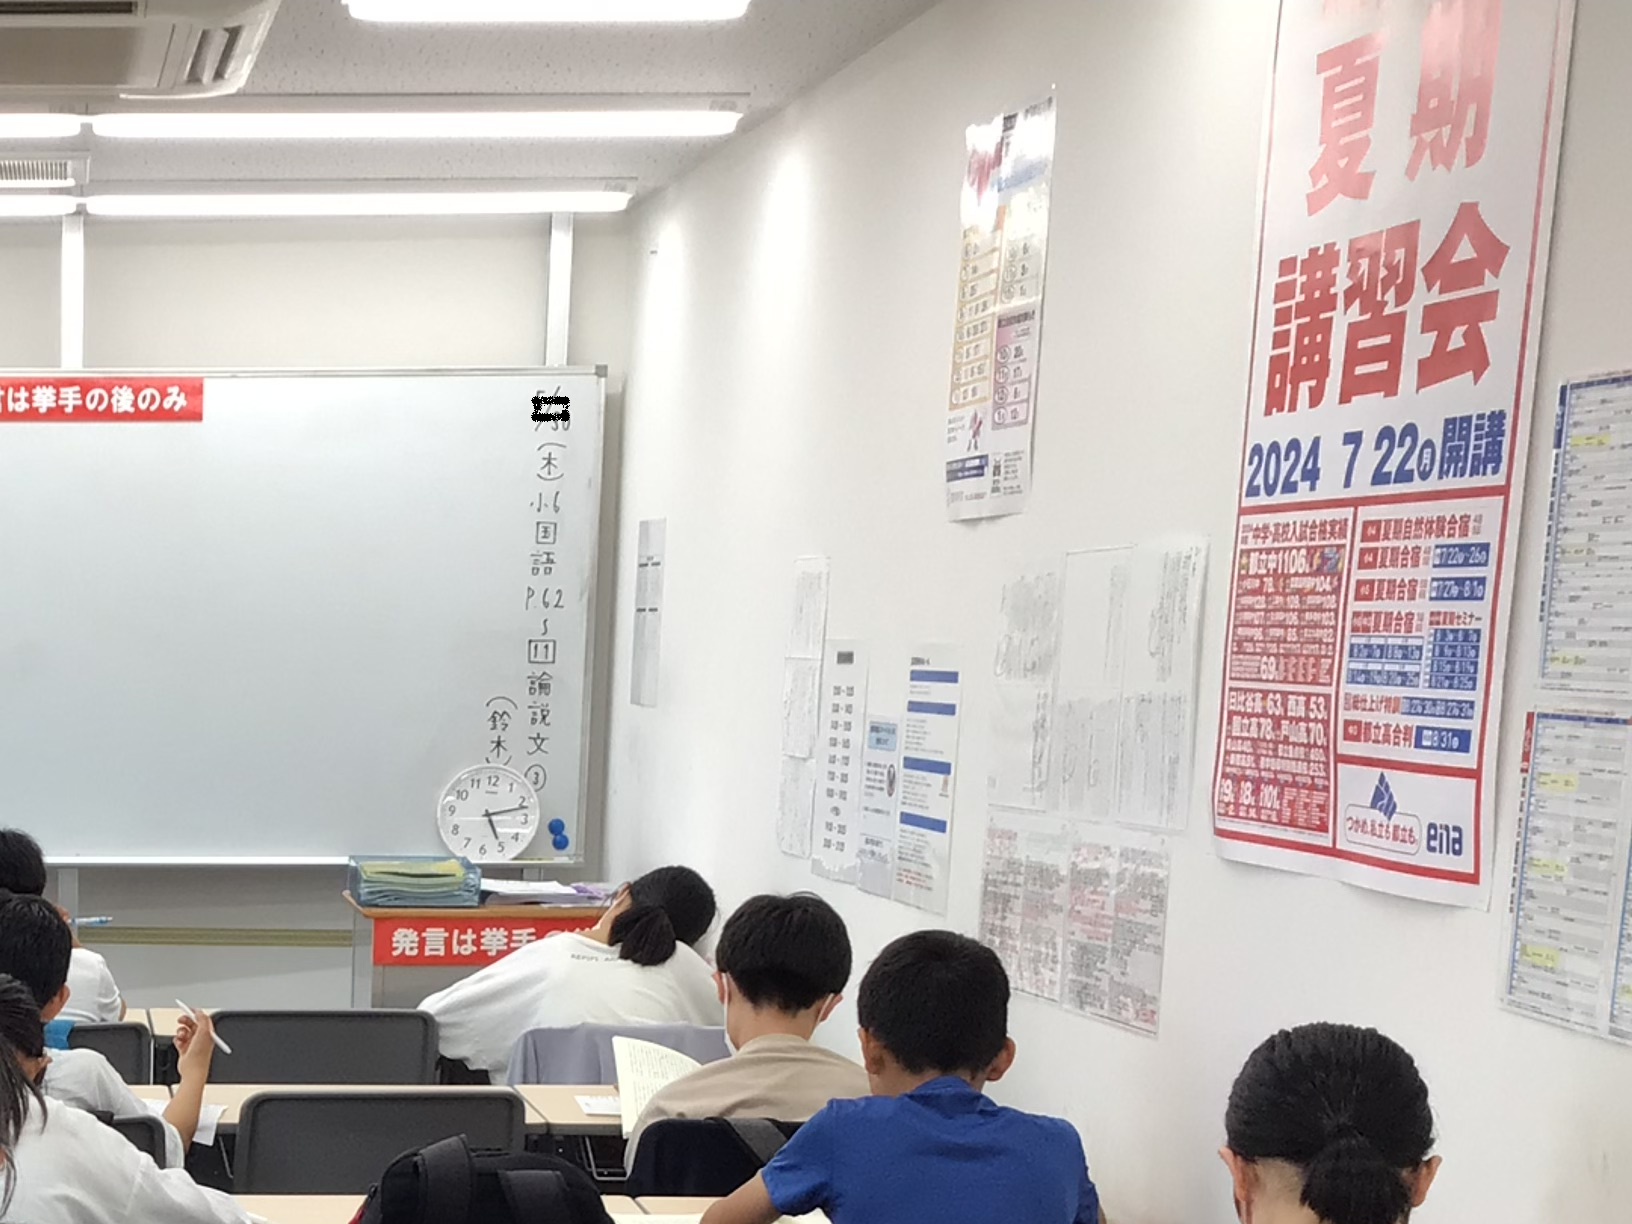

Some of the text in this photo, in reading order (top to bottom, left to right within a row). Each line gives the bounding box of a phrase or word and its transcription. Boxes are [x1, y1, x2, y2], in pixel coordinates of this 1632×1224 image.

[1264, 201, 1511, 417] 講習会
[1245, 434, 1321, 498] 2024
[1342, 431, 1364, 488] 7
[470, 778, 481, 789] 11
[488, 775, 500, 787] 12
[509, 782, 514, 793] 1
[456, 789, 469, 801] 10
[518, 796, 526, 807] 2
[448, 805, 456, 816] 9
[521, 813, 528, 825] 3
[451, 824, 460, 835] 8
[463, 837, 472, 848] 7
[511, 832, 519, 842] 4
[1426, 822, 1463, 857] ena
[479, 844, 487, 855] 6
[497, 841, 505, 853] 5
[392, 926, 594, 957] 発言は挙手
